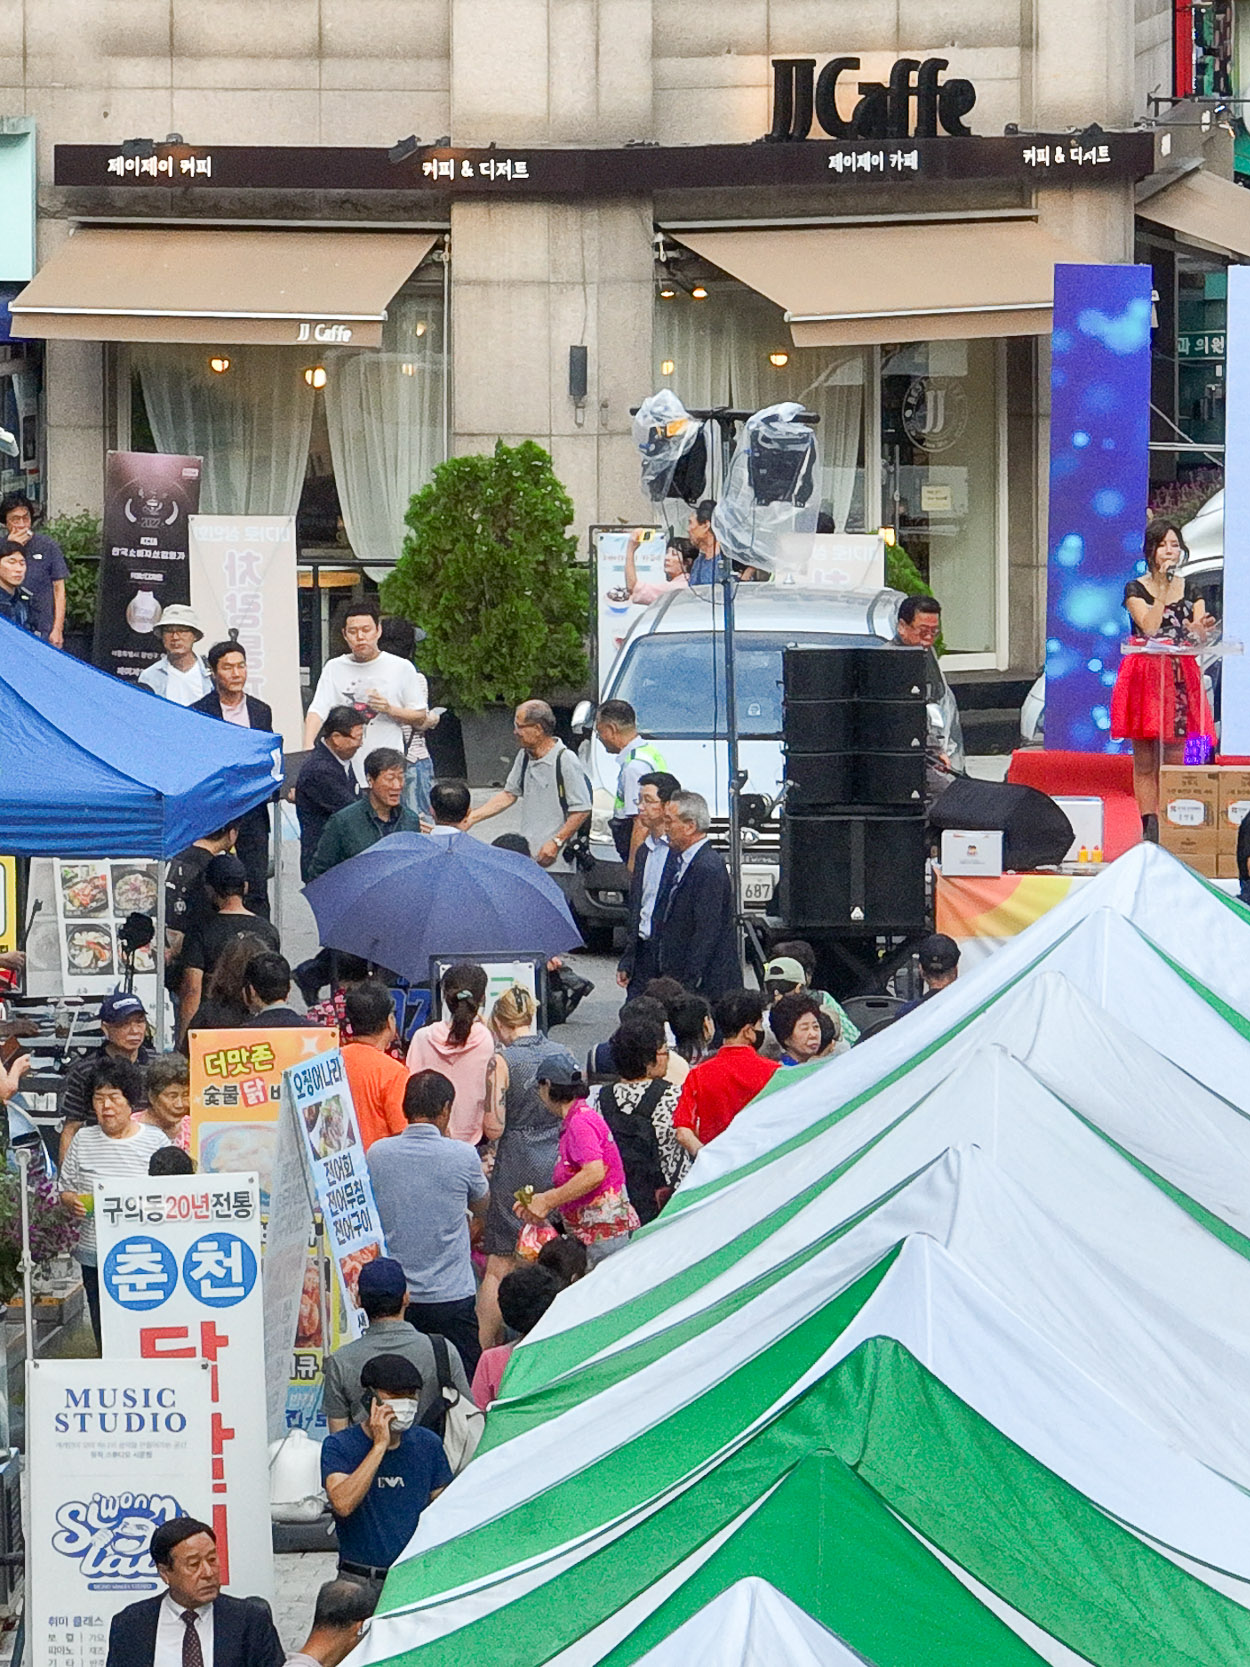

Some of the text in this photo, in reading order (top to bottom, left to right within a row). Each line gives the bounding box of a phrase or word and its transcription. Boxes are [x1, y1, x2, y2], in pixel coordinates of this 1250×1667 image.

[107, 155, 212, 177] 제이제이 커피
[828, 151, 884, 172] 제이제이
[1022, 146, 1051, 166] 커피
[1055, 149, 1066, 164] &
[422, 158, 530, 181] 커피 & 디저트
[296, 323, 353, 342] JJ Caffe
[204, 1042, 276, 1078] 더맛존
[323, 1151, 355, 1187] 전어회
[326, 1179, 366, 1217] 전어무침
[333, 1207, 373, 1246] 전어구이
[64, 1388, 177, 1409] MUSIC
[54, 1412, 188, 1434] STUDIO
